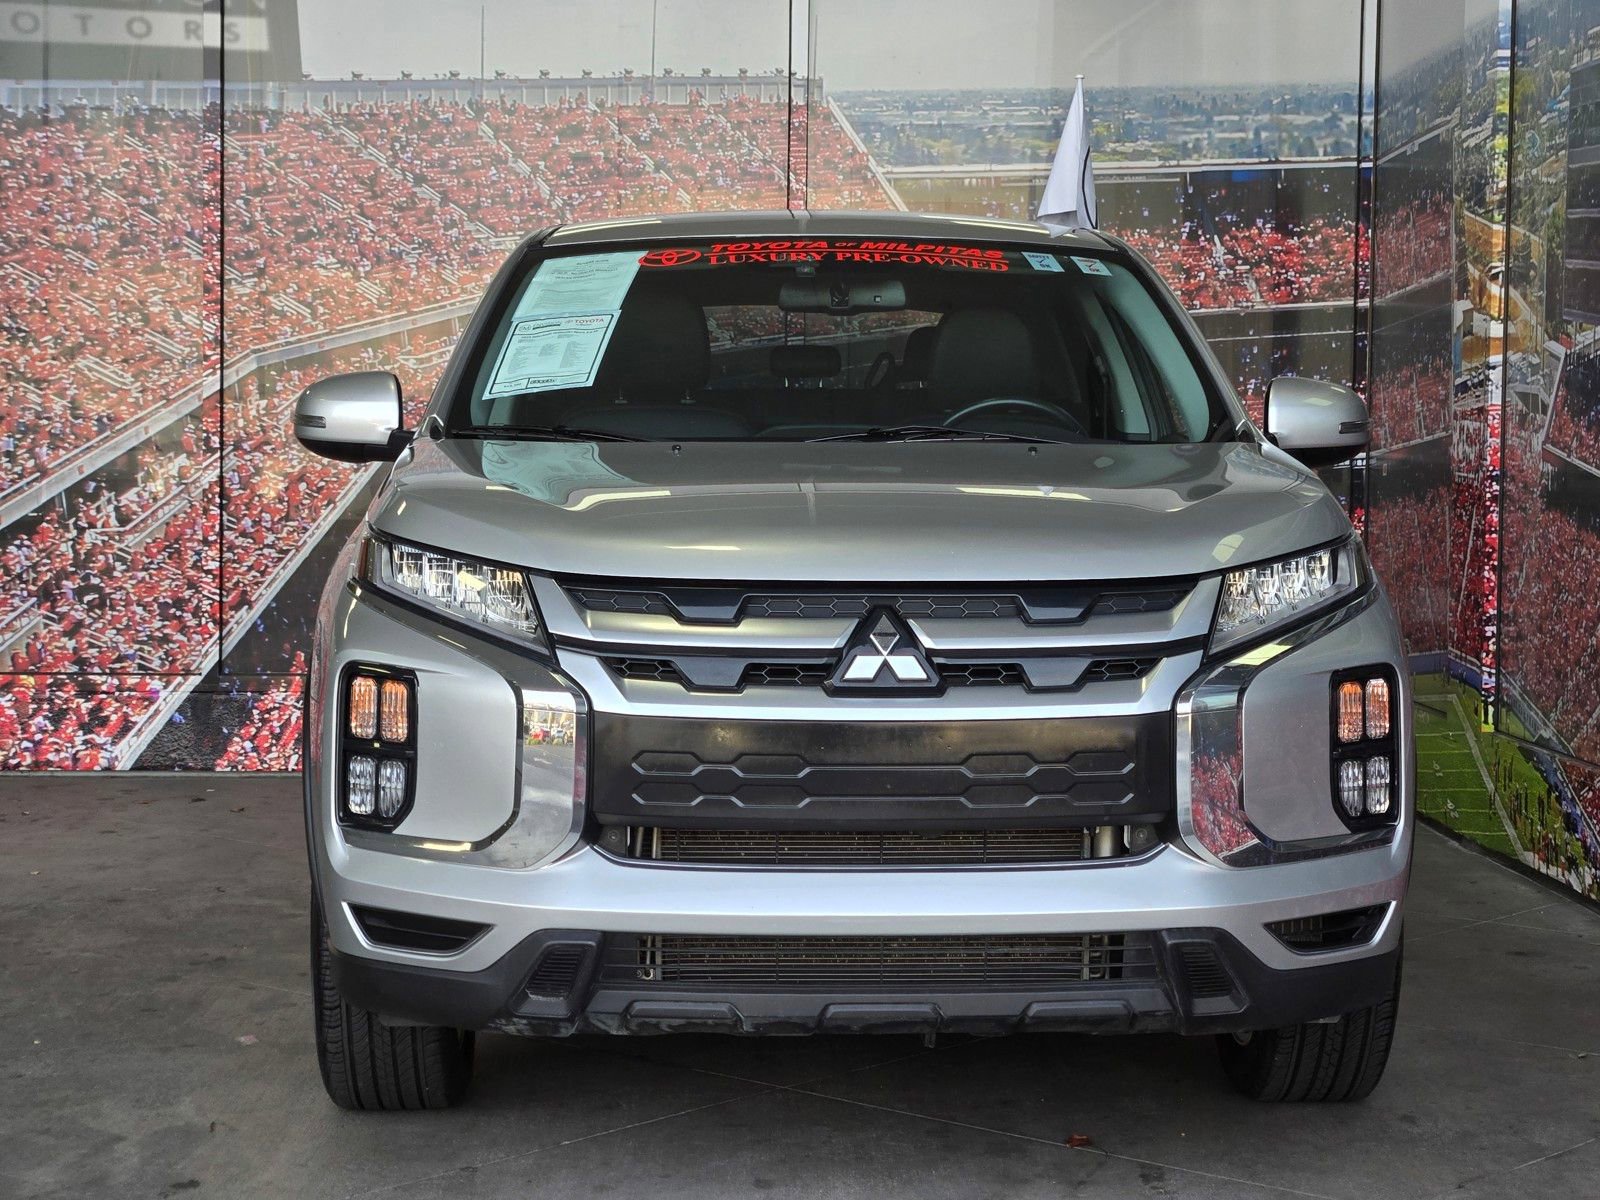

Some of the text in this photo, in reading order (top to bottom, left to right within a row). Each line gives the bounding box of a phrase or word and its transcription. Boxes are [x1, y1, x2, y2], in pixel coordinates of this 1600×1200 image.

[710, 241, 828, 253] TOYOTA
[860, 241, 1004, 259] MILPITAS
[710, 252, 1010, 272] LUXURY PRE-OWNED
